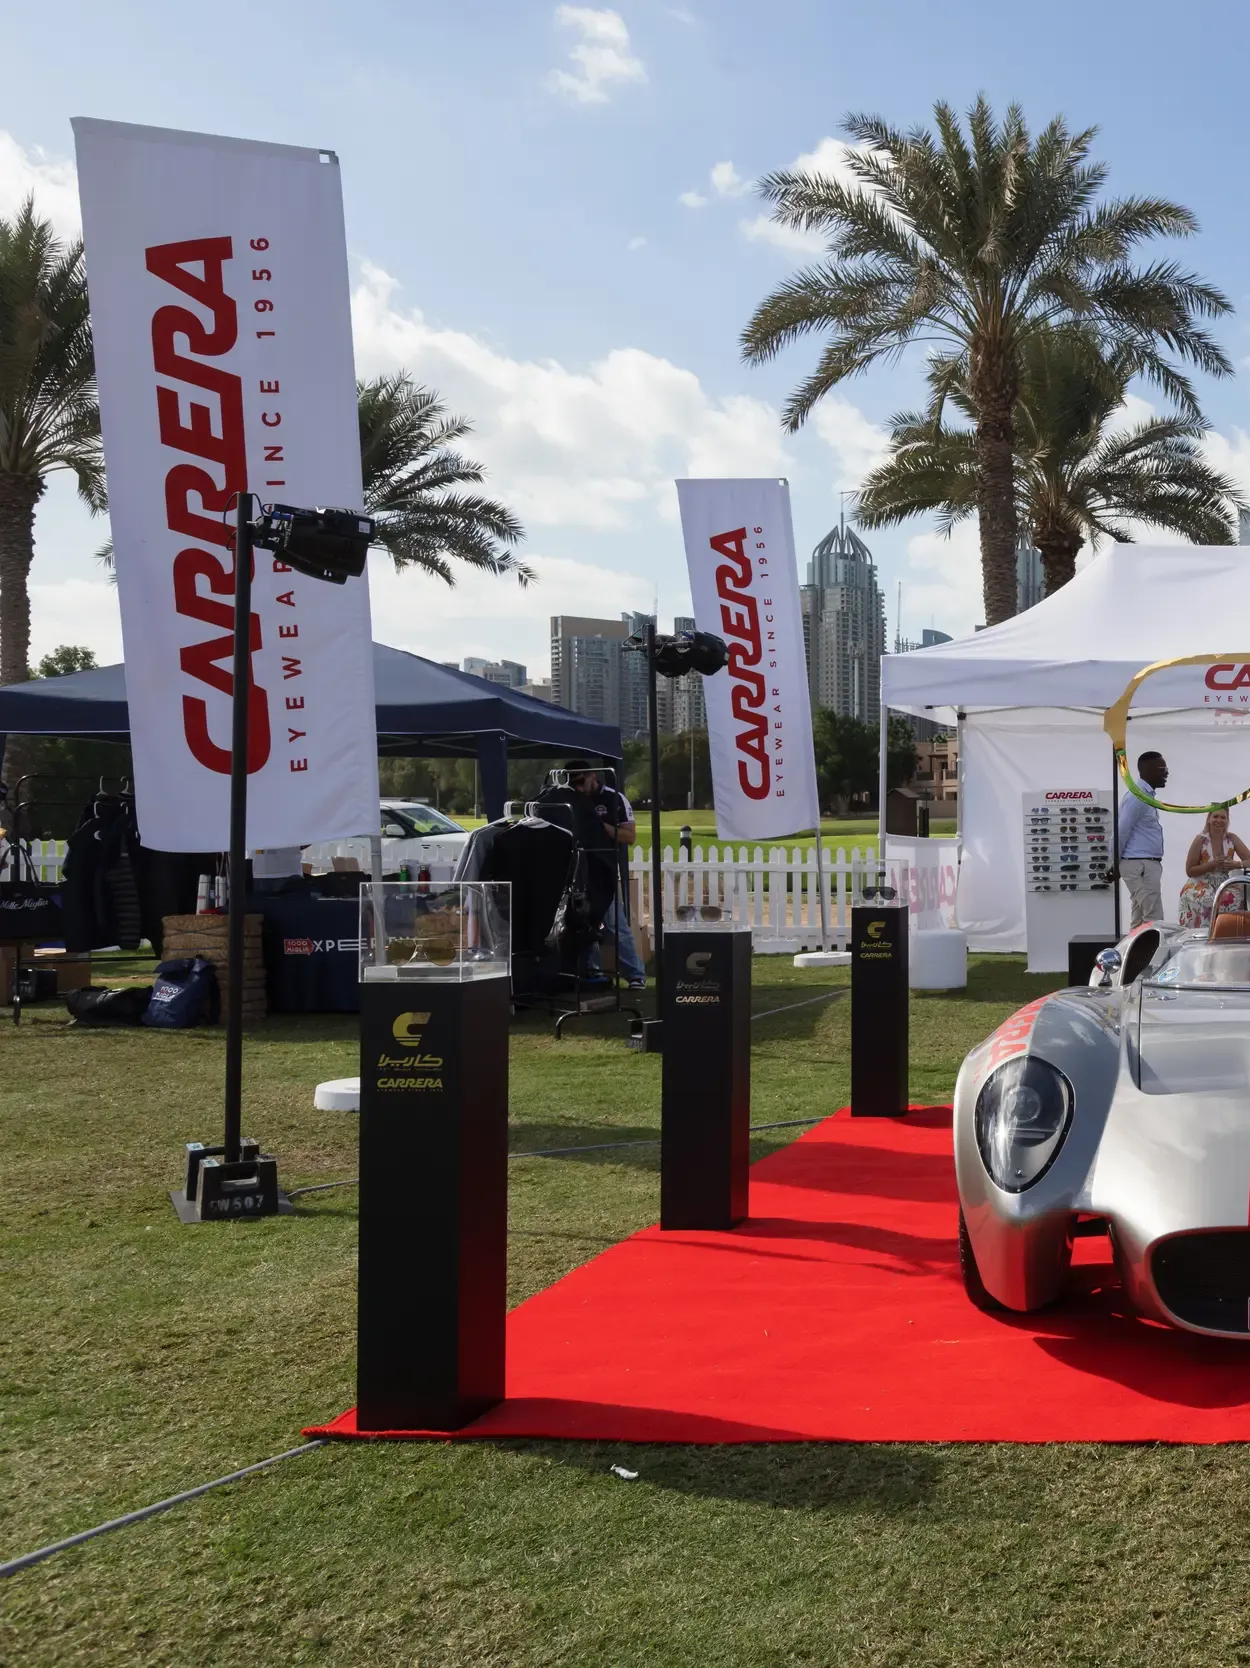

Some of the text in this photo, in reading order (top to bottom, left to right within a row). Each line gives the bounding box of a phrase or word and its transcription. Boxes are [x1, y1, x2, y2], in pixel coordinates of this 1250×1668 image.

[250, 237, 276, 339] 1956
[145, 236, 271, 776] CARRERA
[709, 527, 770, 800] CARRERA
[753, 526, 785, 797] EYEWEAR SINCE 1956
[1045, 791, 1093, 800] CARRERA
[377, 1078, 443, 1088] CARRERA
